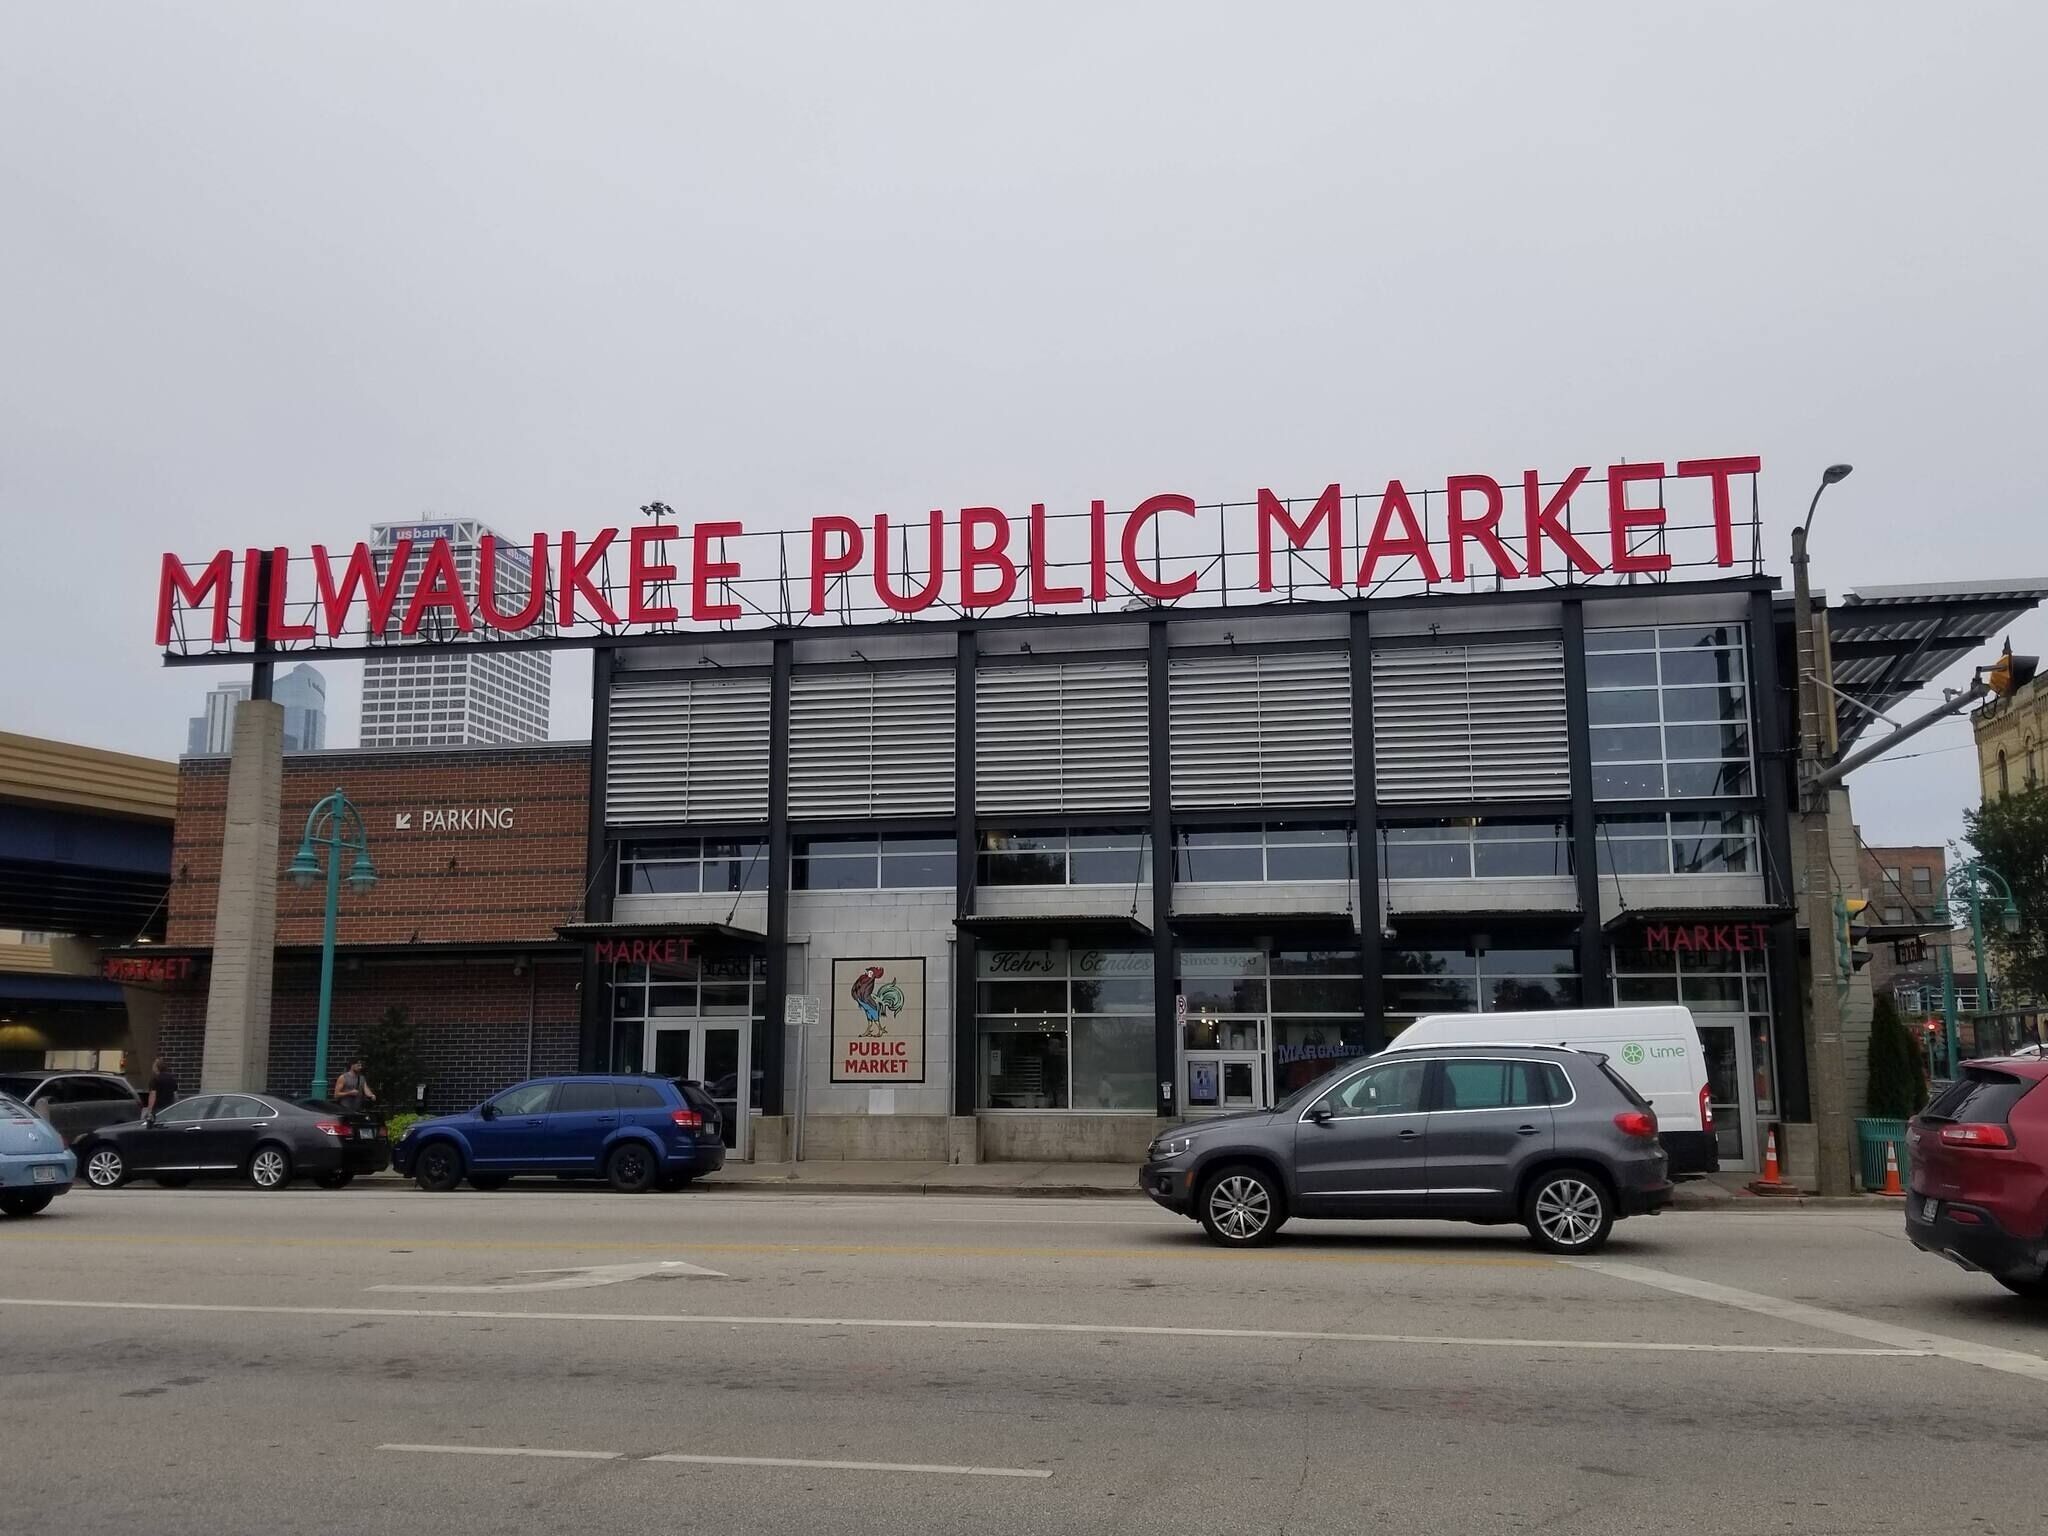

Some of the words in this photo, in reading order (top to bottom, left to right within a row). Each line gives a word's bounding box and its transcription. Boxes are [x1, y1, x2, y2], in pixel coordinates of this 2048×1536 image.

[396, 527, 448, 540] usbank
[155, 521, 742, 645] MILWAUKEE
[810, 495, 1198, 615] PUBLIC
[1257, 456, 1761, 591] MARKET
[422, 807, 514, 831] PARKING
[1647, 924, 1769, 951] MARKET
[594, 939, 693, 963] MARKET
[990, 951, 1054, 972] Kehr's
[1080, 951, 1151, 972] Candies
[1182, 954, 1219, 966] Since
[849, 1041, 906, 1056] PUBLIC
[1650, 1047, 1685, 1058] Lime
[845, 1059, 908, 1073] MARKET
